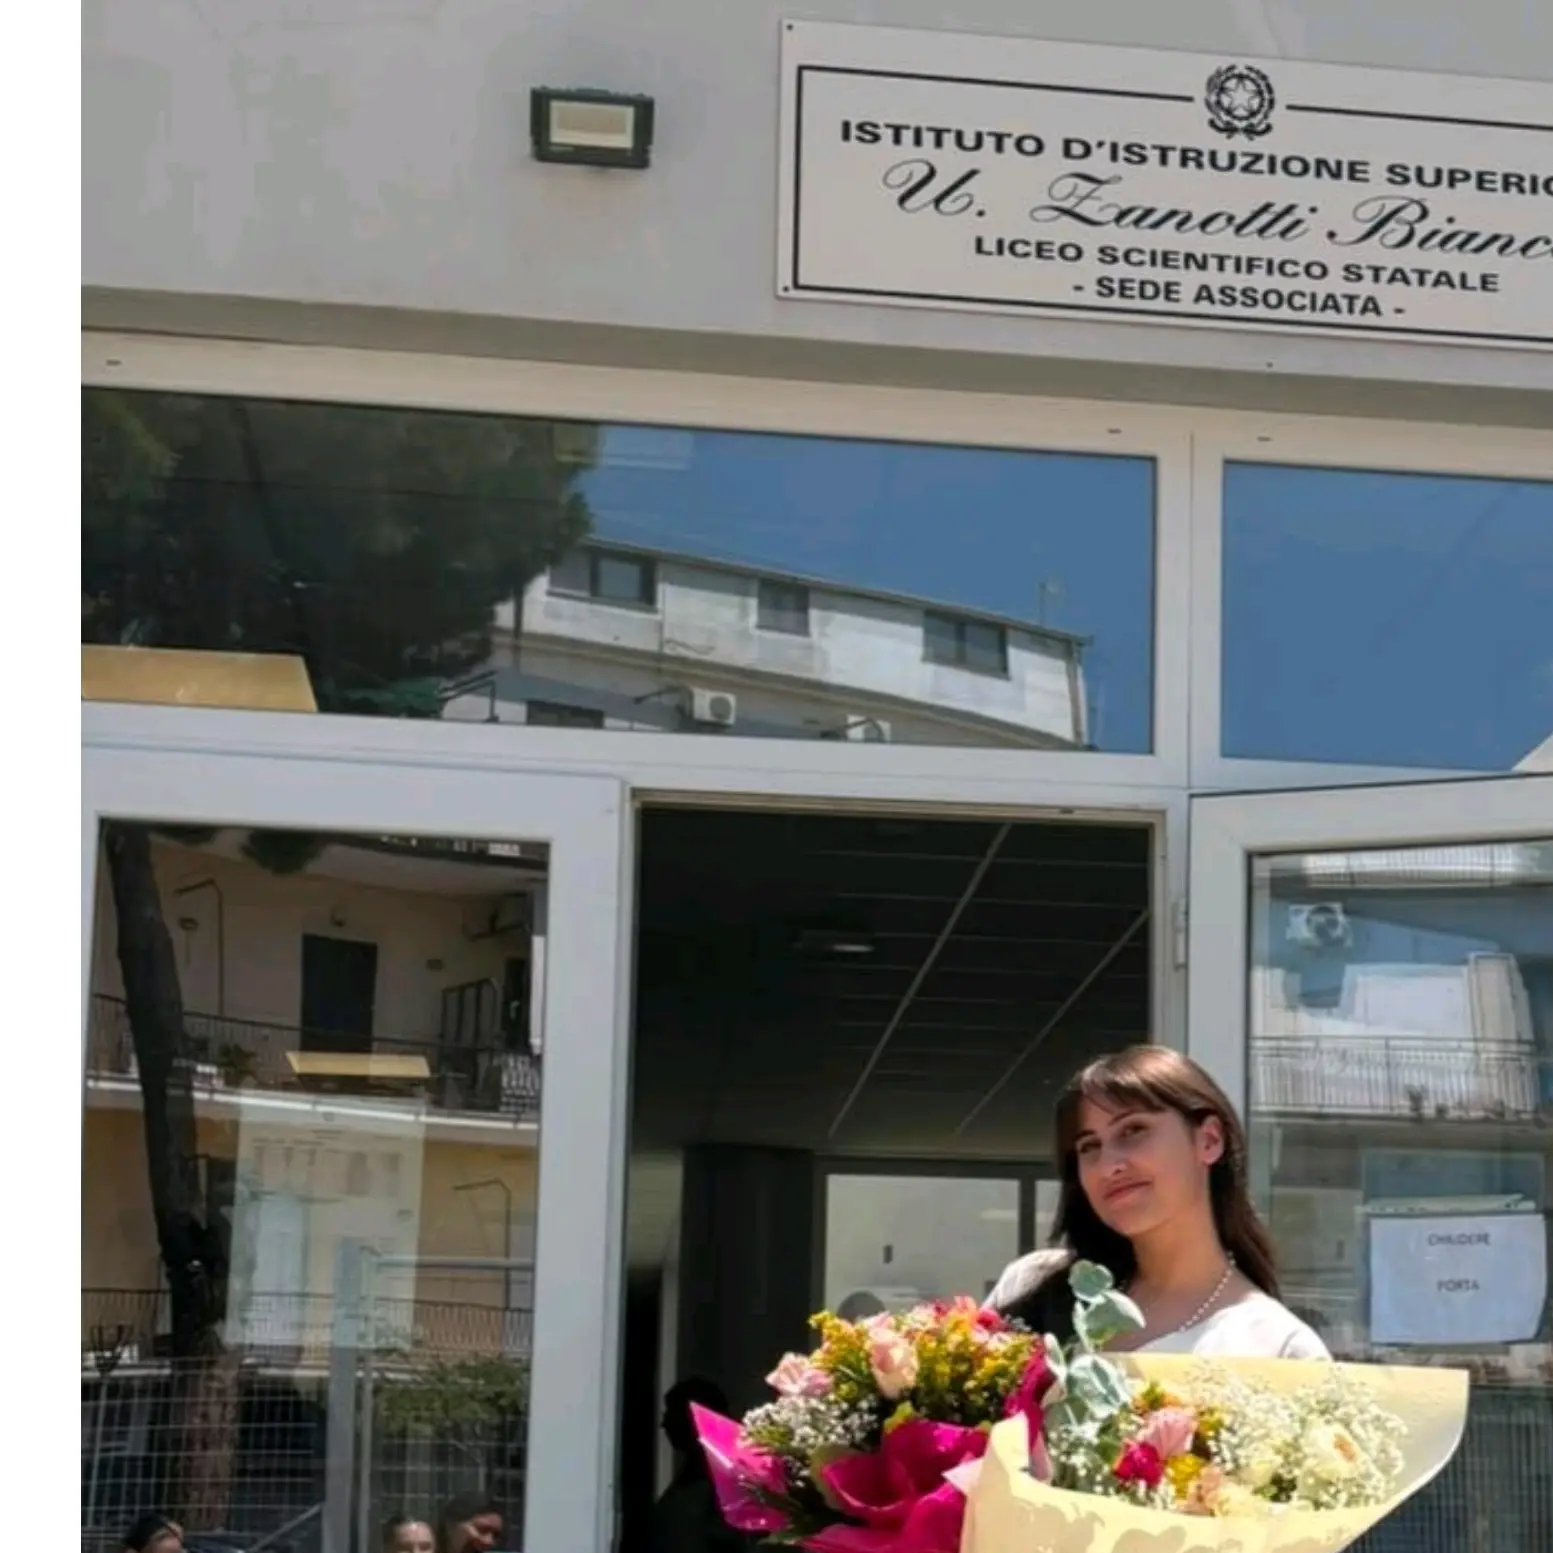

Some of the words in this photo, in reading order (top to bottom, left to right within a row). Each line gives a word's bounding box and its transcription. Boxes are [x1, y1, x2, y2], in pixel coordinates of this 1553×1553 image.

[841, 119, 1046, 157] ISTITUTO
[1063, 135, 1369, 185] D'ISTRUZIONE
[882, 158, 987, 219] U.
[1031, 172, 1311, 245] Zanotti
[974, 235, 1085, 263] LICEO
[1097, 246, 1328, 283] SCIENTIFICO
[1342, 263, 1499, 293] STATALE
[1095, 275, 1182, 304] SEDE
[1193, 284, 1382, 317] ASSOCIATA
